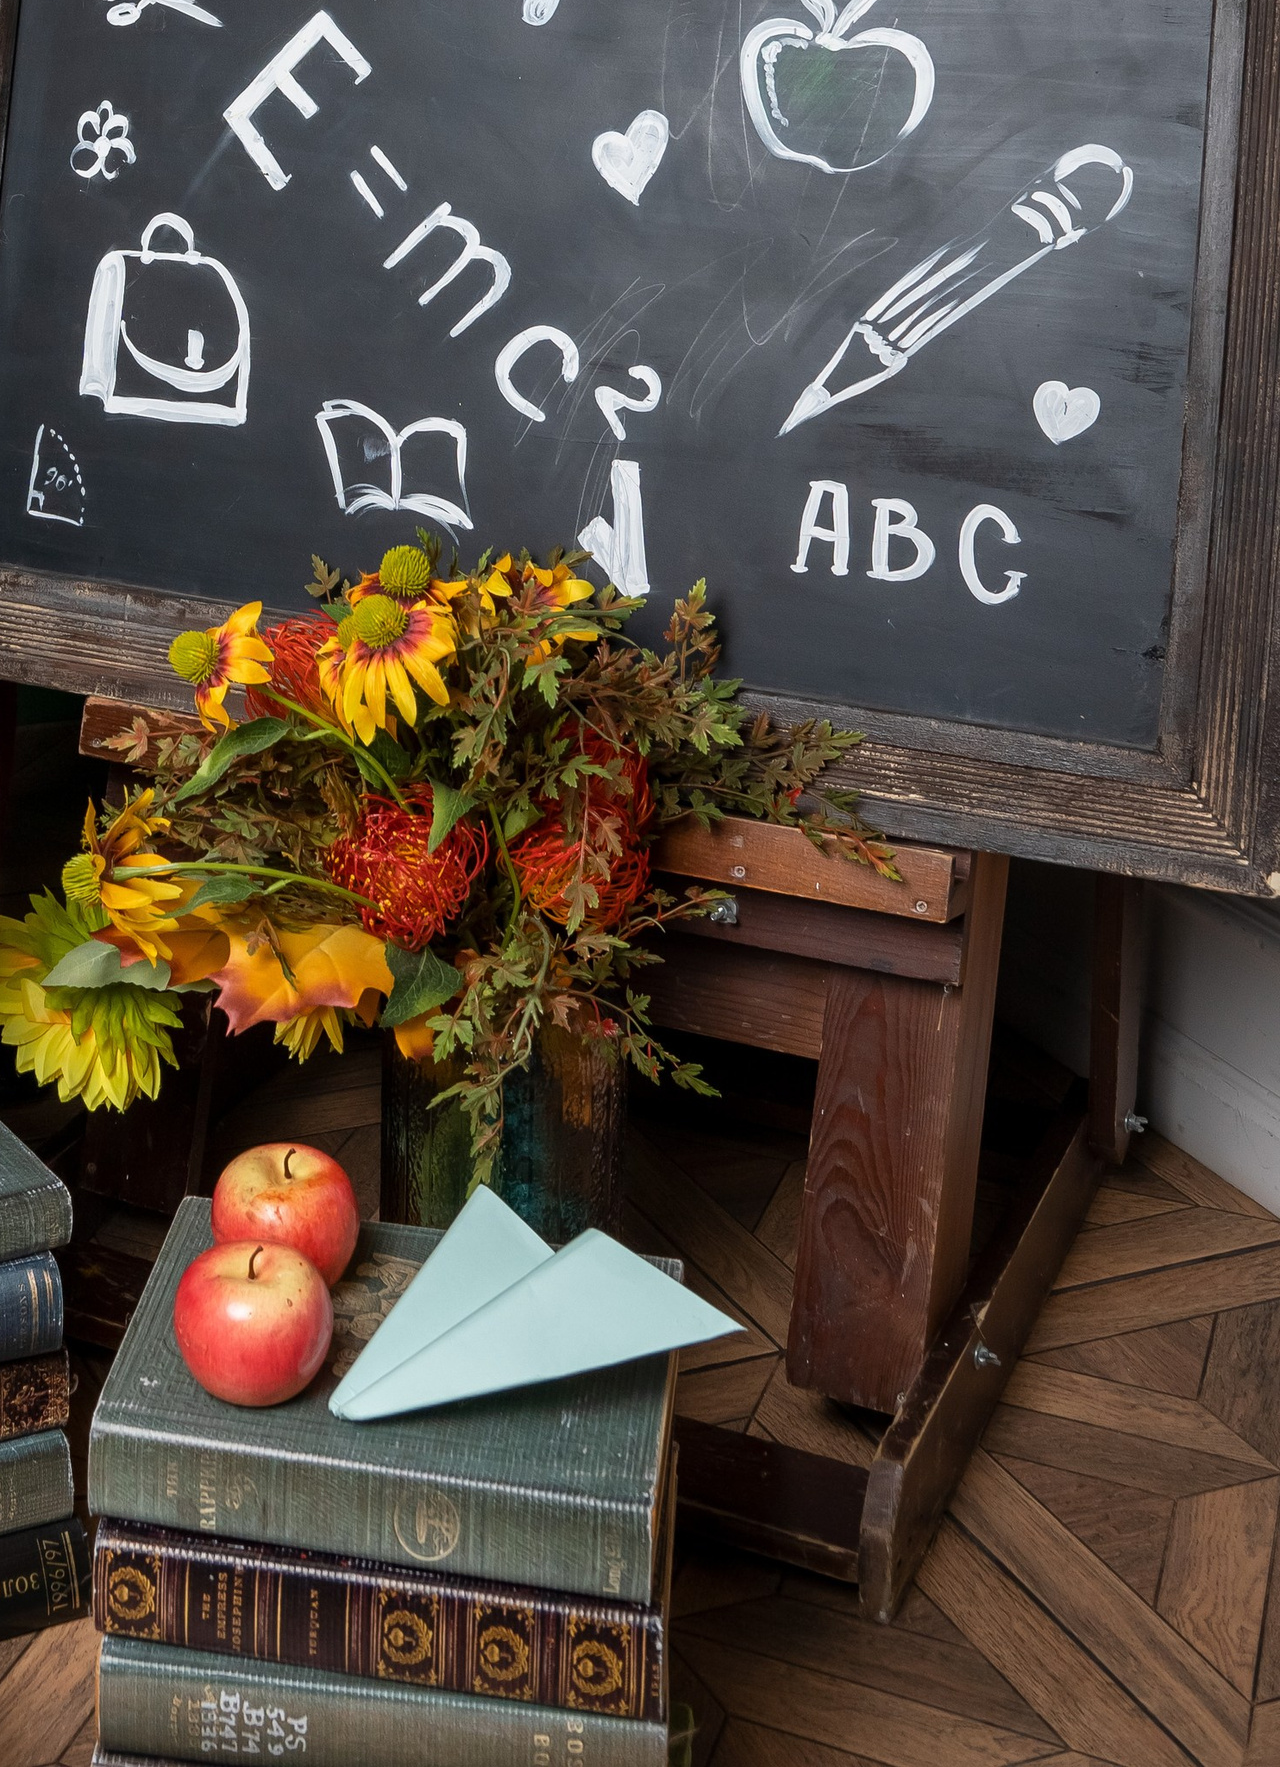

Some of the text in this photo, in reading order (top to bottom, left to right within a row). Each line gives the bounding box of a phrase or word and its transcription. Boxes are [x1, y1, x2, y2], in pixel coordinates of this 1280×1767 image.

[47, 1537, 68, 1611] 1996/97
[202, 1593, 211, 1620] THE
[217, 1571, 229, 1640] EMPRESS
[285, 1714, 308, 1753] PS
